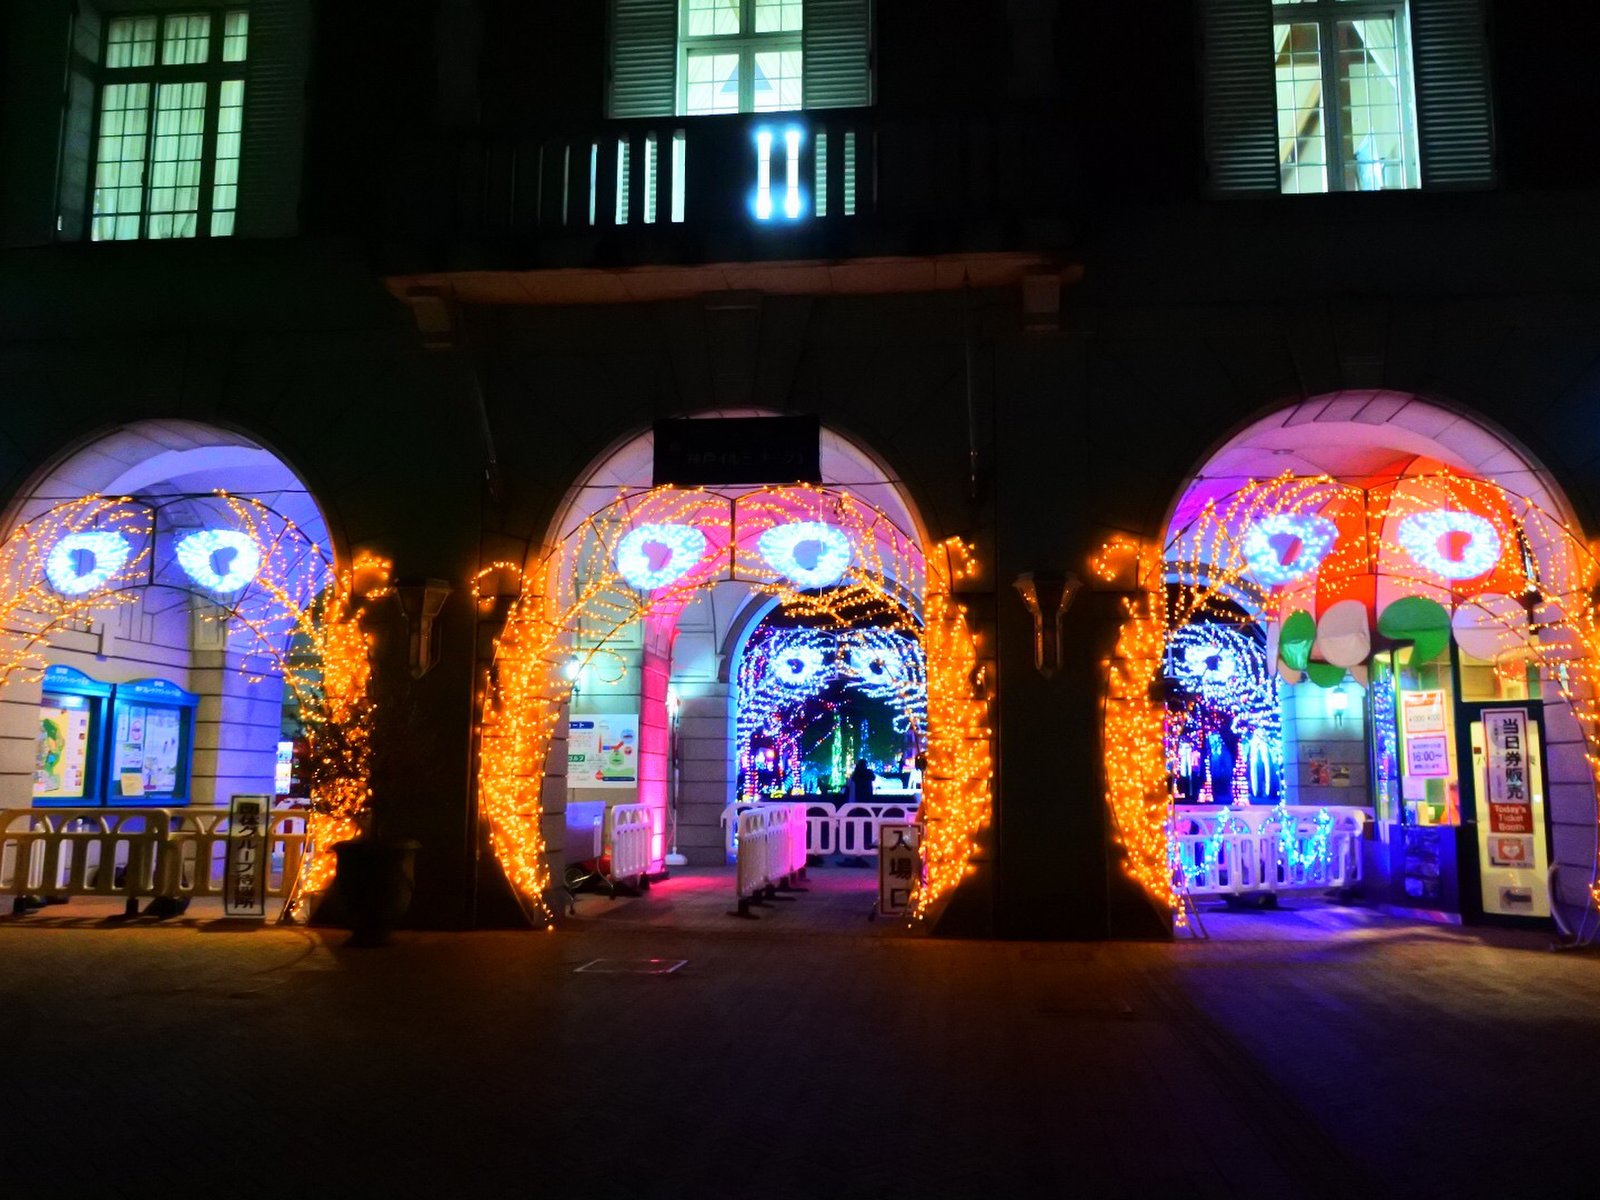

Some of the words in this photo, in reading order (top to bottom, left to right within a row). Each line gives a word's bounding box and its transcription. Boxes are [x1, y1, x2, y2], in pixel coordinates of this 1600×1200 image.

[1503, 718, 1524, 800] 当日券販売
[1494, 804, 1526, 815] Today's
[1498, 813, 1524, 823] Ticket
[1498, 823, 1525, 832] Booth
[889, 830, 913, 909] 入場口
